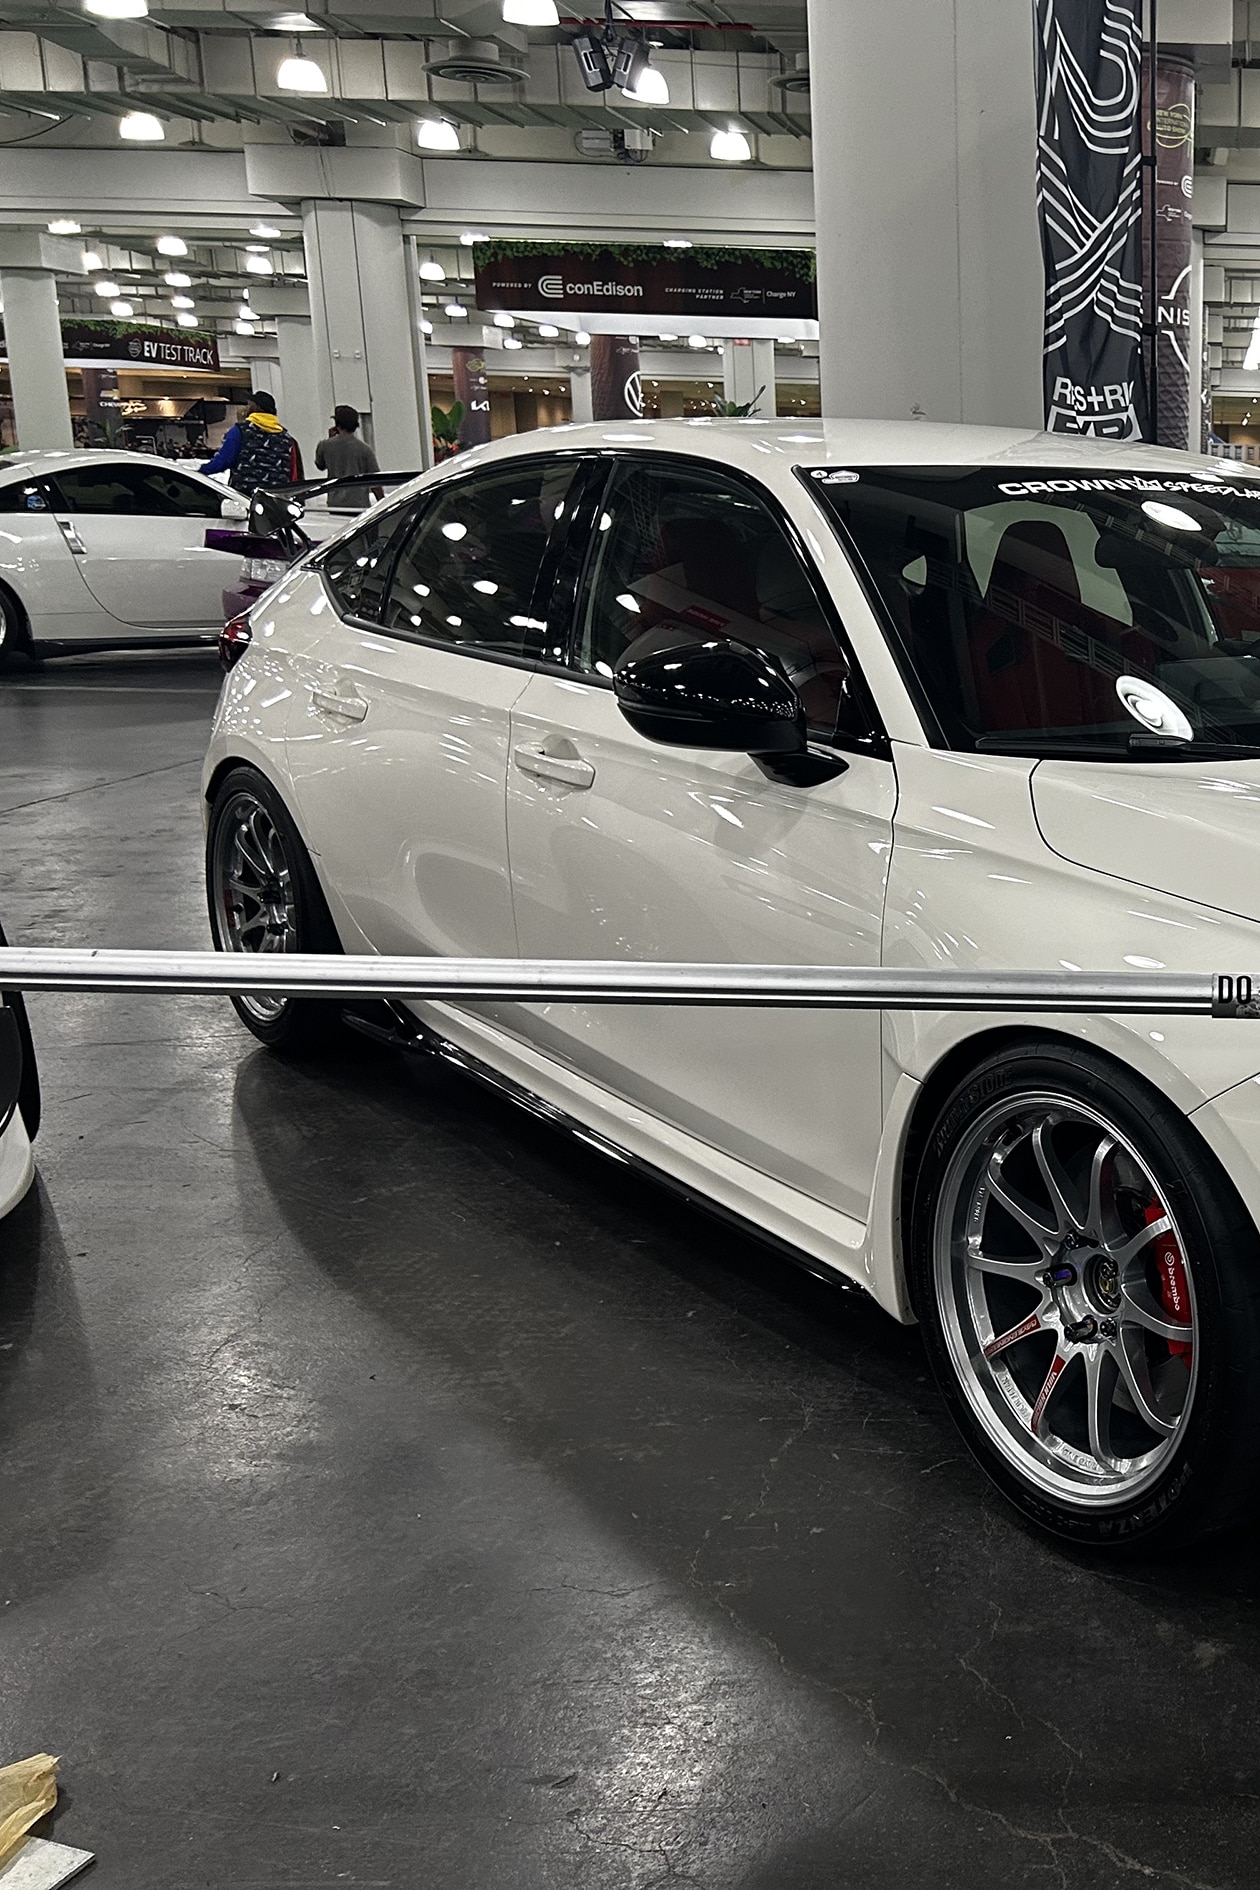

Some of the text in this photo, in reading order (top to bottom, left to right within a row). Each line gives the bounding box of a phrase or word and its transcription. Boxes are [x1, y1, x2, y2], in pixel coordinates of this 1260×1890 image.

[492, 281, 522, 289] POWERED
[566, 281, 643, 297] conEdison
[766, 290, 787, 299] Charge
[143, 340, 214, 366] EV TEST TRACK
[998, 478, 1134, 496] CROWN
[1217, 975, 1254, 1006] DO
[1167, 1266, 1181, 1311] brembo
